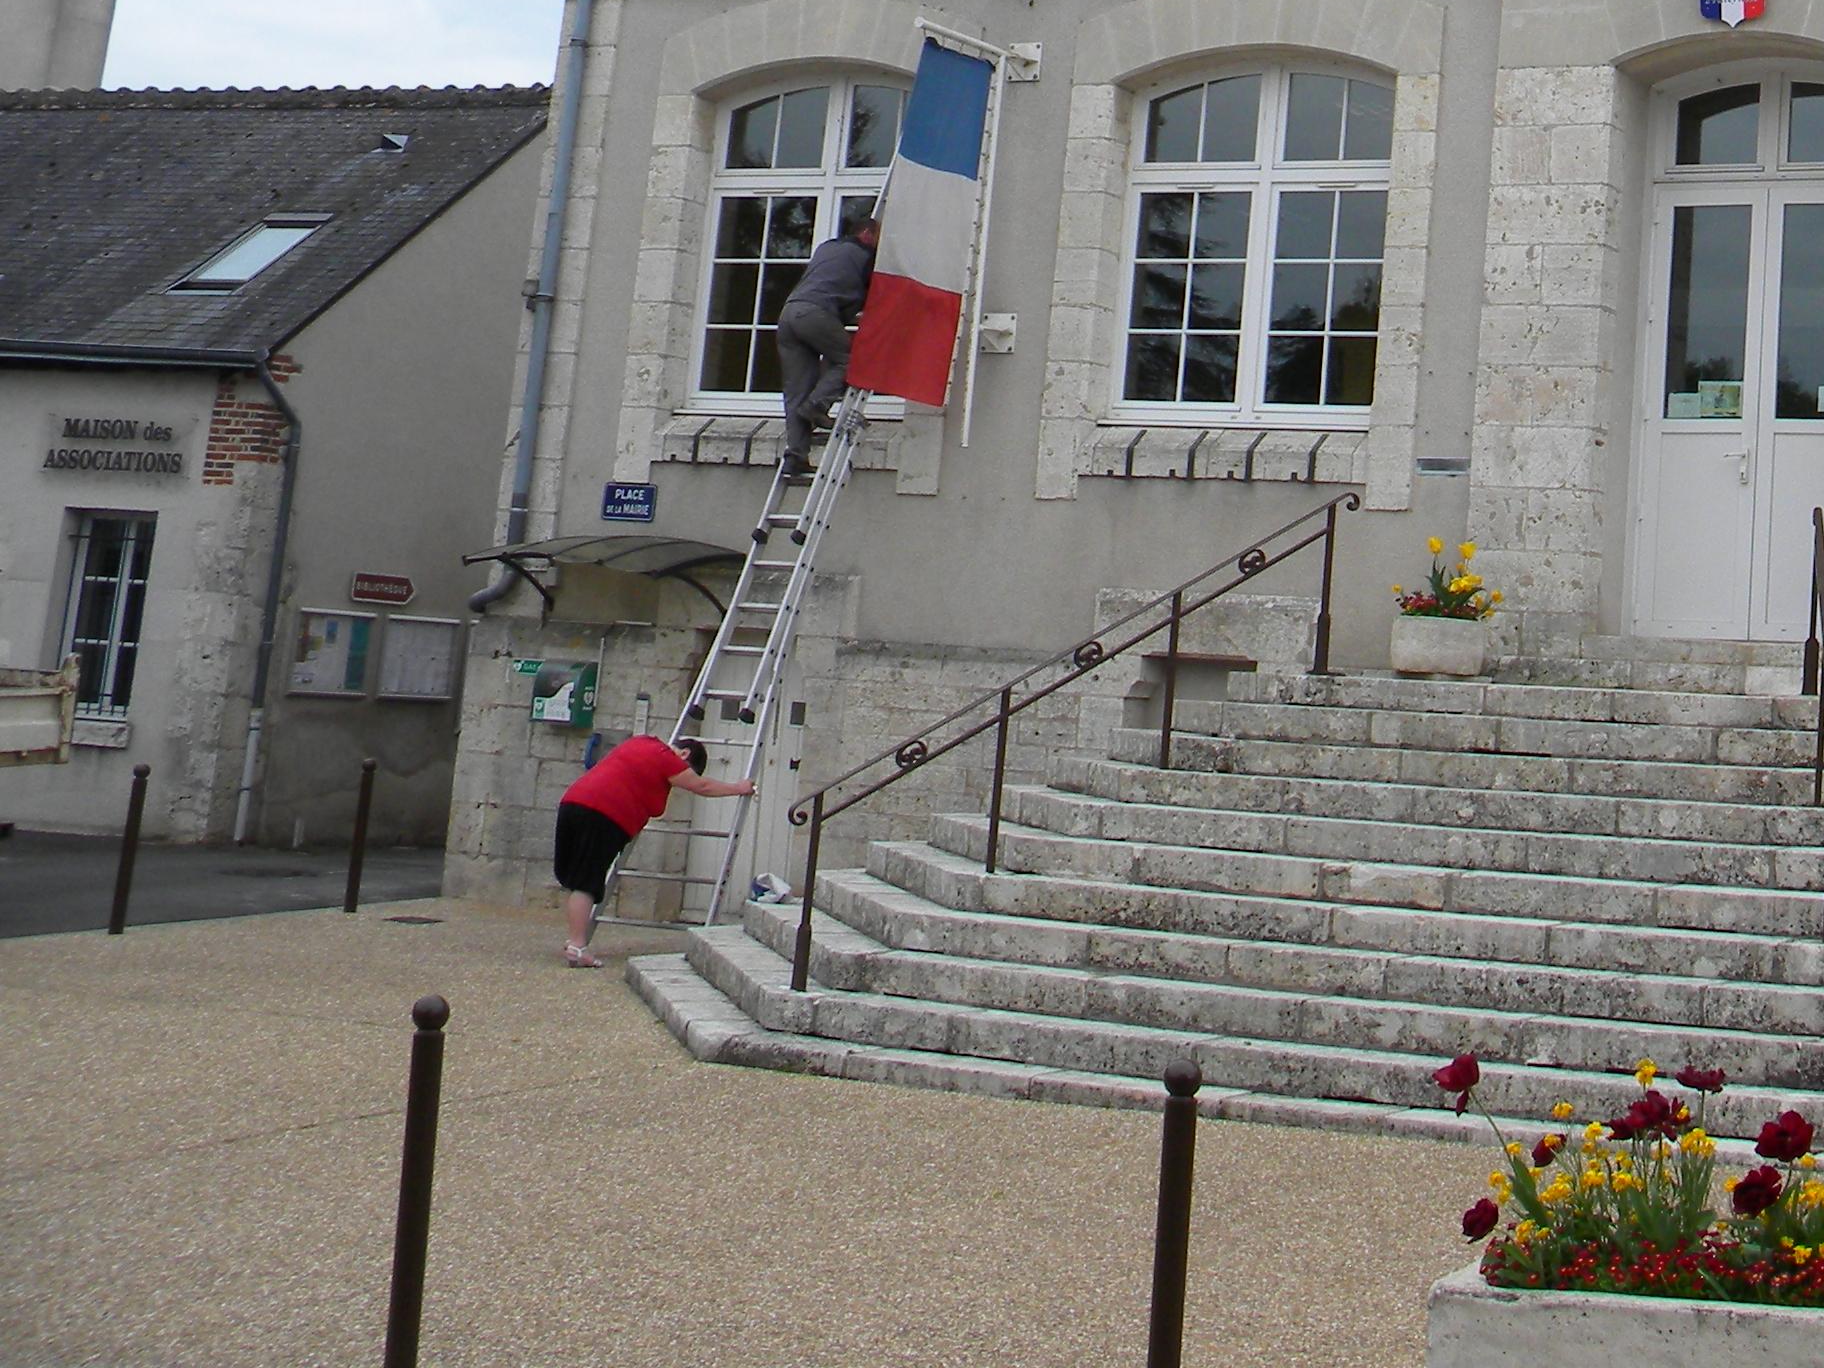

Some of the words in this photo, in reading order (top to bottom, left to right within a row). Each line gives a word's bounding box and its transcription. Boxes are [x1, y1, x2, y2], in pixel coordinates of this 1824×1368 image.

[63, 418, 138, 440] MAISON
[143, 422, 172, 441] des
[43, 449, 182, 474] ASSOCIATIONS
[615, 488, 645, 501] PLACE
[623, 503, 650, 516] MAIRIE
